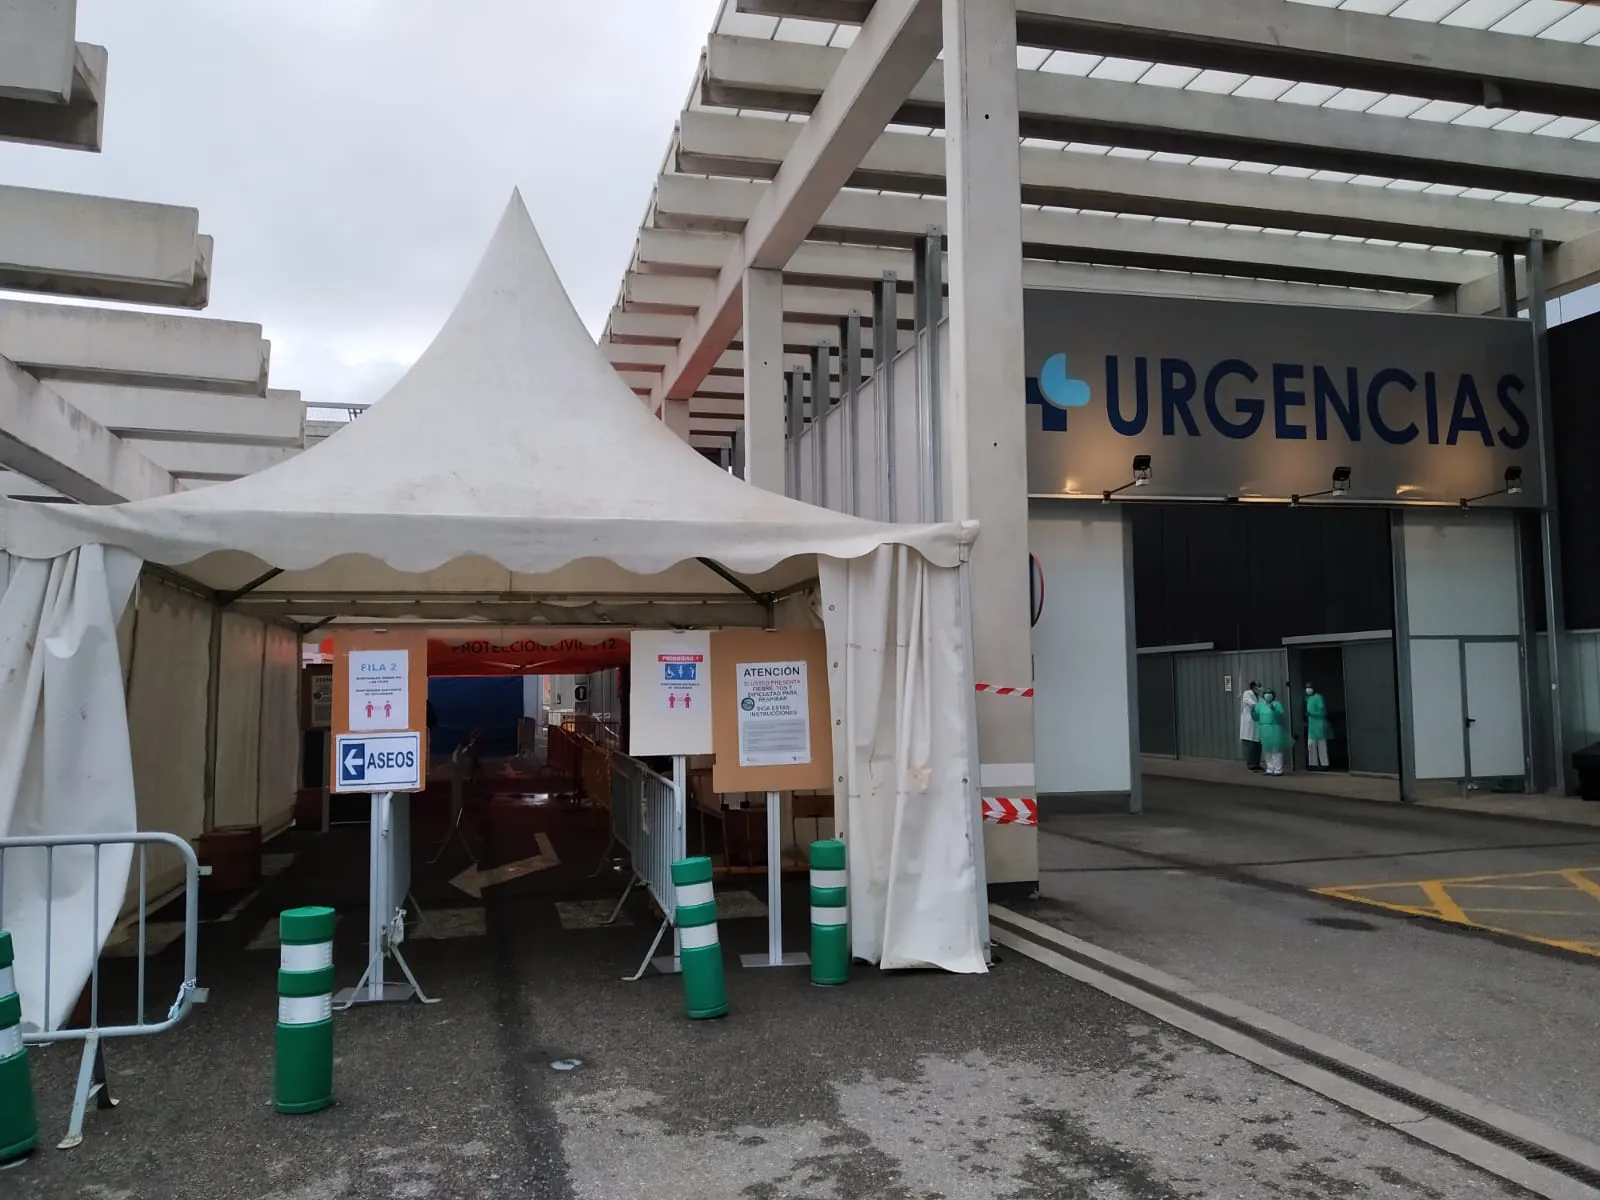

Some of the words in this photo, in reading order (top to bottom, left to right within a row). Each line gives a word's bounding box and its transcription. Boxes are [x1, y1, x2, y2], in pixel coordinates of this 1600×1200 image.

[1105, 355, 1530, 450] URGENCIAS
[360, 663, 386, 672] FILA
[390, 662, 397, 671] 2
[366, 751, 414, 770] ASEOS
